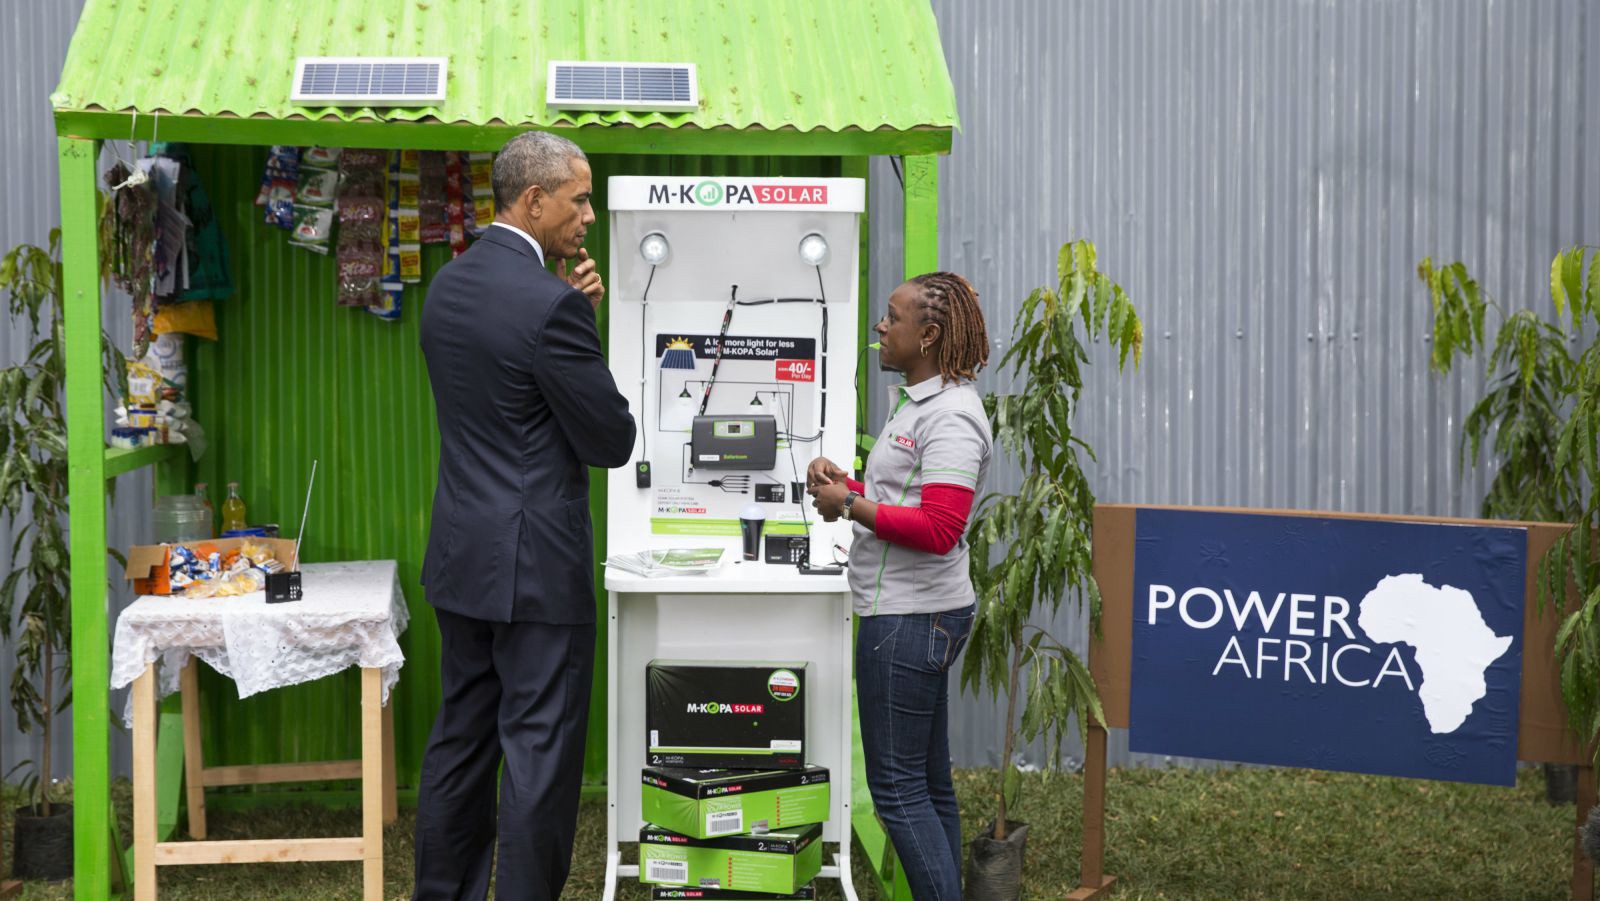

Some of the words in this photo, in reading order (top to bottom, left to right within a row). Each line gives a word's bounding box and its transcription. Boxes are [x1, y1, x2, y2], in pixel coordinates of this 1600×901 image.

[649, 181, 753, 206] M-KOPA
[762, 188, 823, 202] SOLAR
[705, 338, 711, 346] A
[747, 339, 764, 348] light
[766, 339, 777, 347] for
[779, 340, 795, 348] less
[723, 347, 753, 355] M-KOPA
[755, 348, 779, 356] Solar!
[788, 362, 811, 374] 40/-
[1148, 584, 1356, 639] POWER
[1212, 635, 1414, 691] AFRICA
[687, 701, 733, 714] M-KOPA
[734, 705, 762, 713] SOLAR
